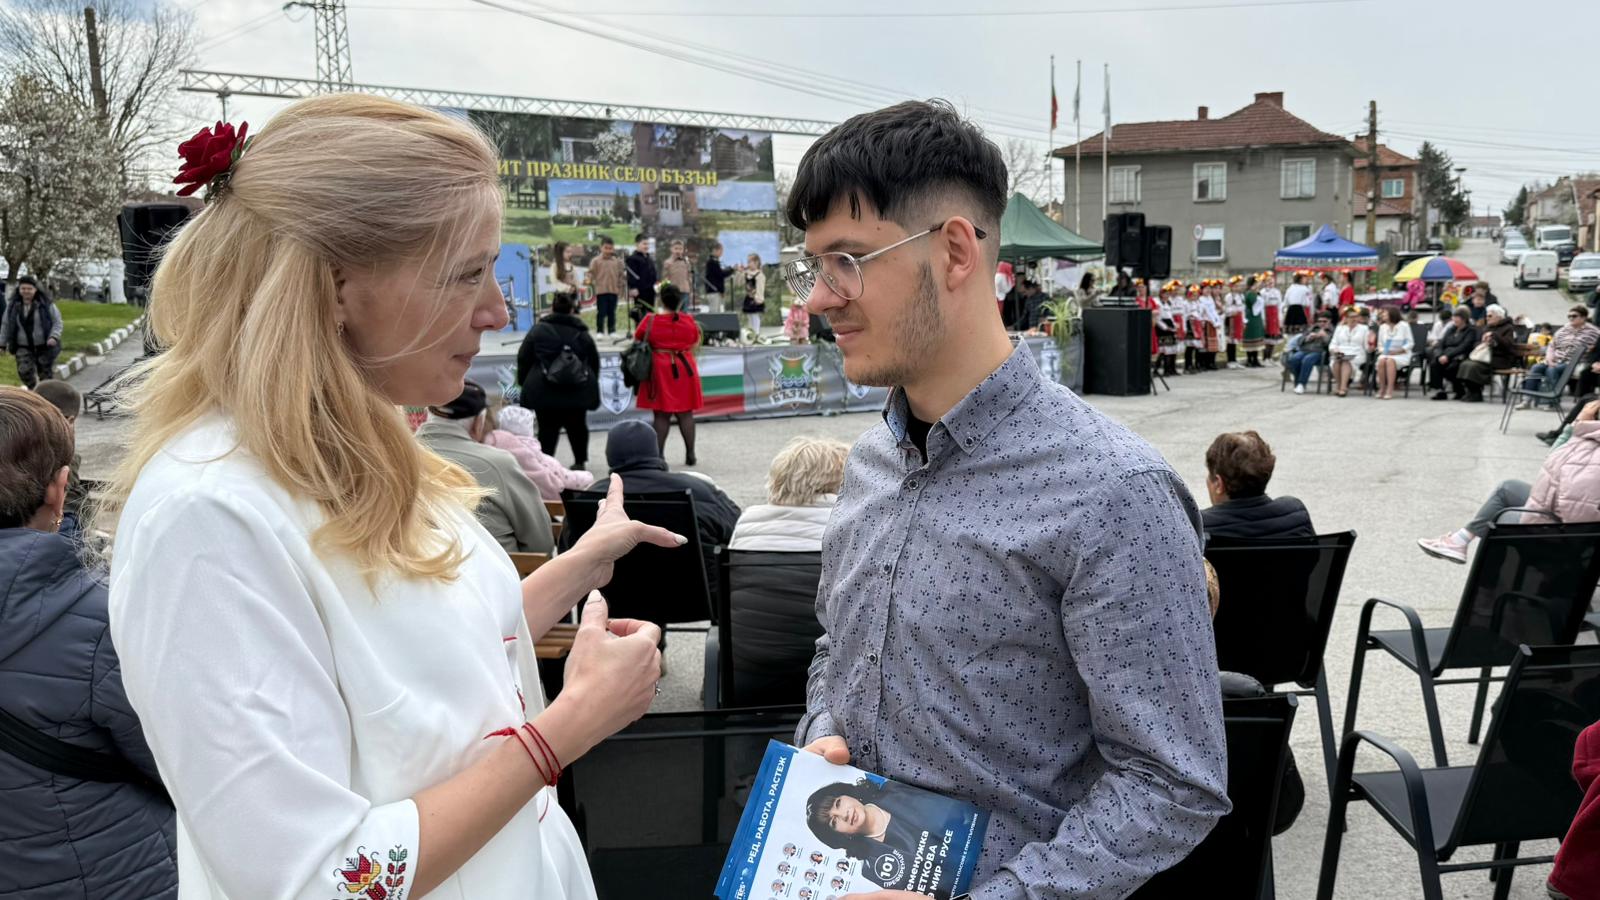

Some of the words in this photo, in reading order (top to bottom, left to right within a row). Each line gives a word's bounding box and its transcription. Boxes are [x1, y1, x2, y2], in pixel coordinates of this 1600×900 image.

[497, 160, 522, 176] ИТ
[526, 160, 610, 180] ПРАЗНИК
[614, 165, 657, 183] СЕЛО
[661, 168, 718, 186] БЪЗЪН
[747, 842, 761, 864] РЕД,
[755, 798, 775, 840] РАБОТА,
[769, 756, 787, 796] РАСТЕЖ
[880, 856, 895, 877] 101
[905, 830, 929, 891] еменужка
[930, 865, 943, 891] МИР
[939, 829, 954, 858] РУСЕ
